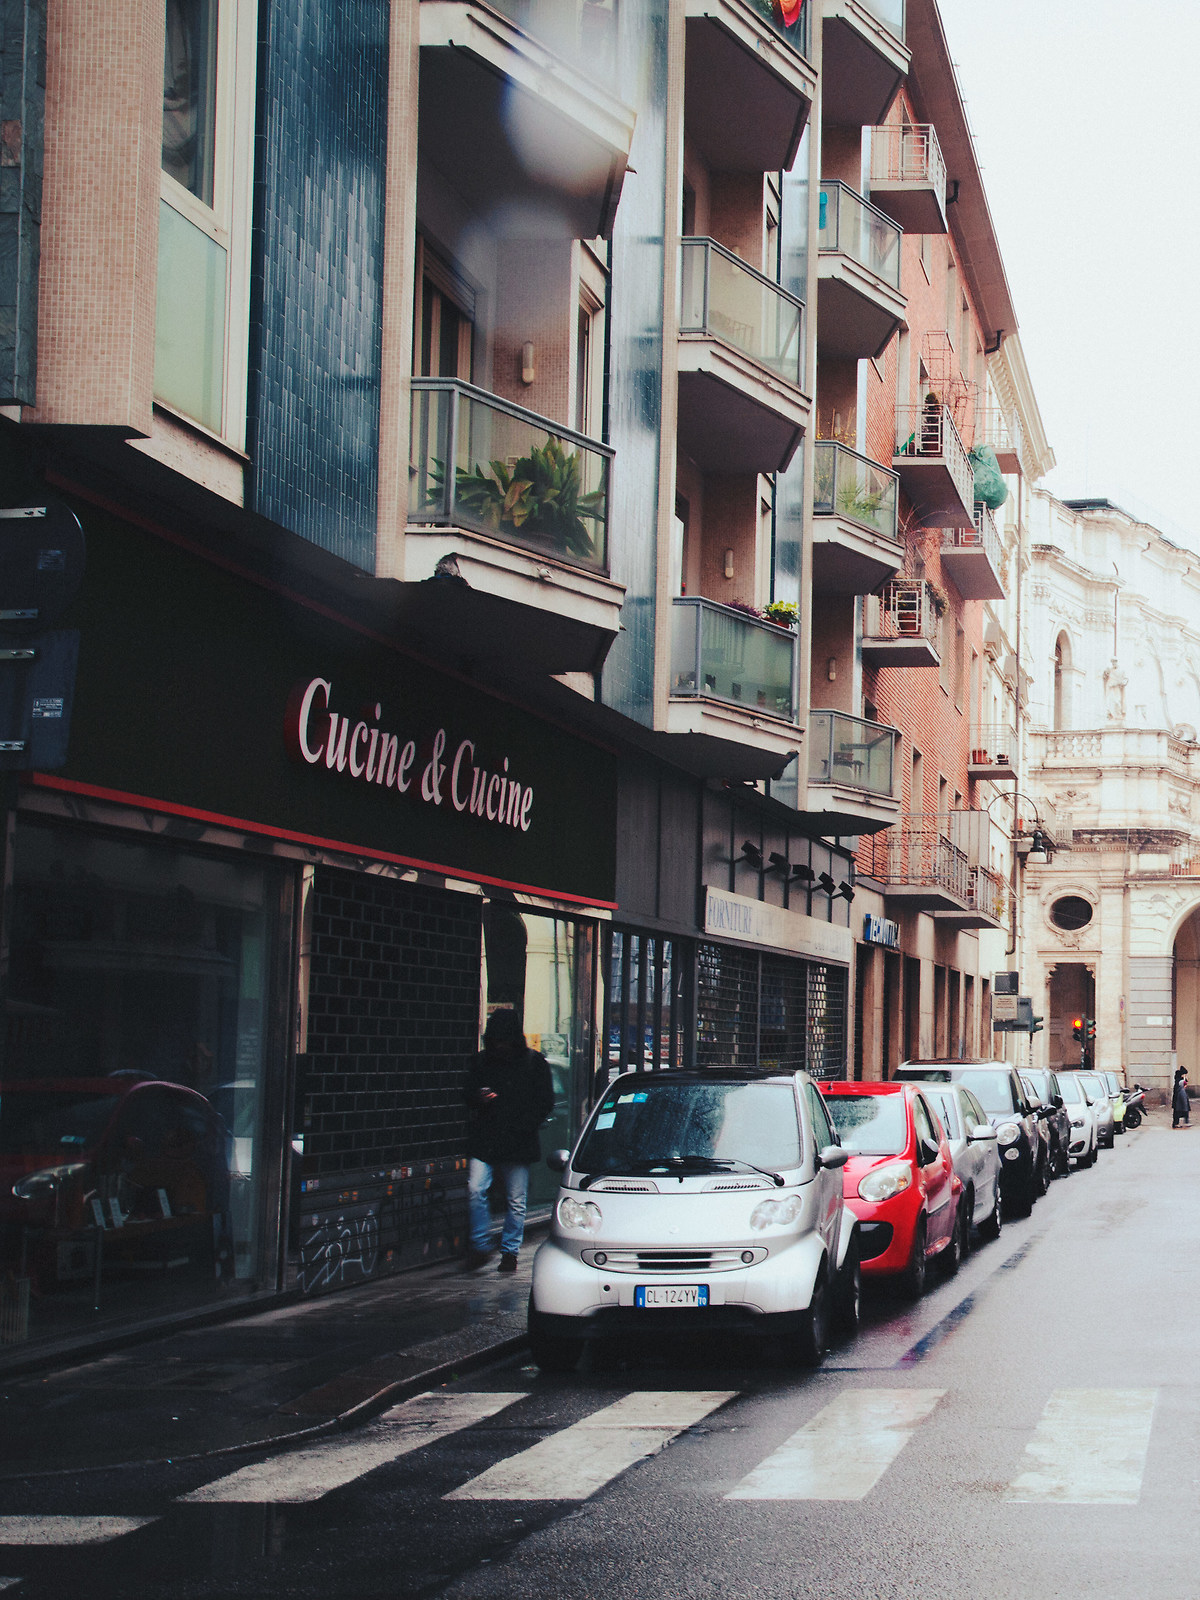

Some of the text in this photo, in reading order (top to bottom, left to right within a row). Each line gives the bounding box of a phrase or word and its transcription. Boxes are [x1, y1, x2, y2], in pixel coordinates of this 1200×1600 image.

[299, 677, 534, 832] Cucine & Cucine
[647, 1291, 659, 1303] CL
